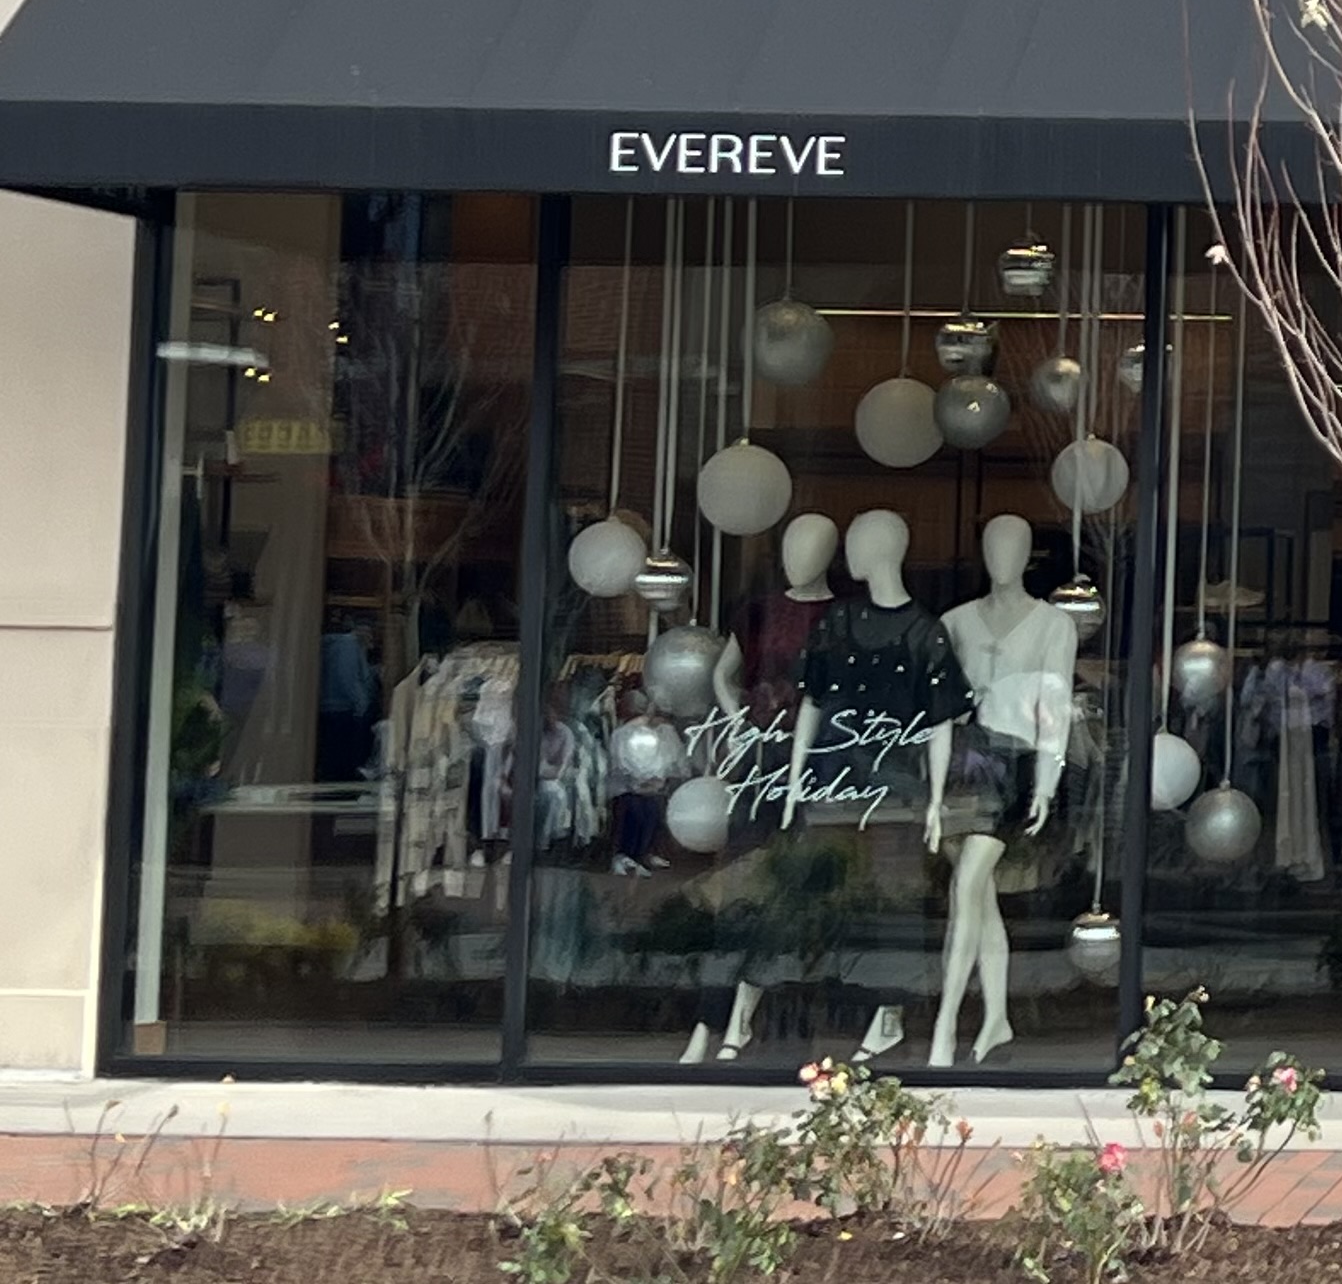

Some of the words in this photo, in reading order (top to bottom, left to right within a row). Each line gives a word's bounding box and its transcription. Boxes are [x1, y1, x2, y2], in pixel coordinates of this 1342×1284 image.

[609, 131, 847, 176] EVEREVE
[684, 705, 796, 780] High
[805, 708, 937, 773] Style
[725, 763, 889, 831] Holiday
